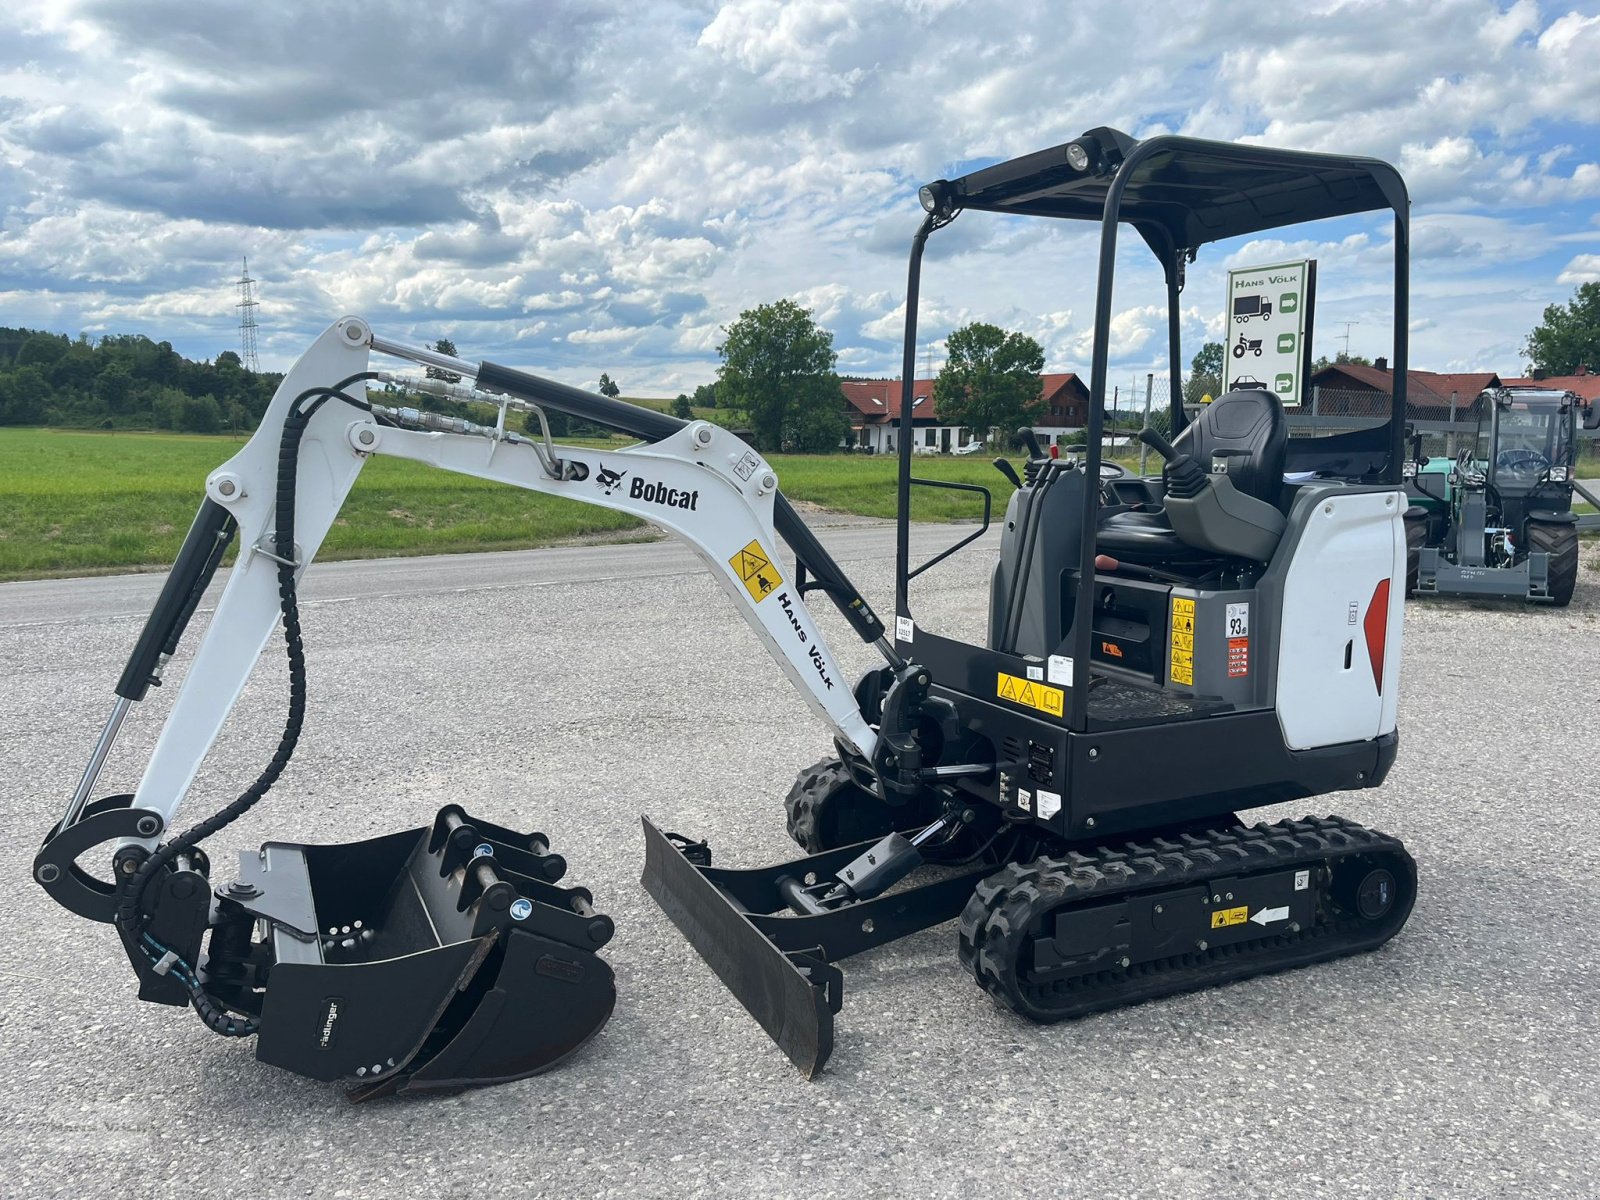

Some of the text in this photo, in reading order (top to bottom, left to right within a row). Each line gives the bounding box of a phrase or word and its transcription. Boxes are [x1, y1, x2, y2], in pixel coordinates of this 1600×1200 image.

[1235, 275, 1297, 289] HANS VÖLK
[629, 477, 699, 511] Bobcat
[1230, 618, 1241, 635] 93
[777, 592, 835, 691] HANS VÖLK
